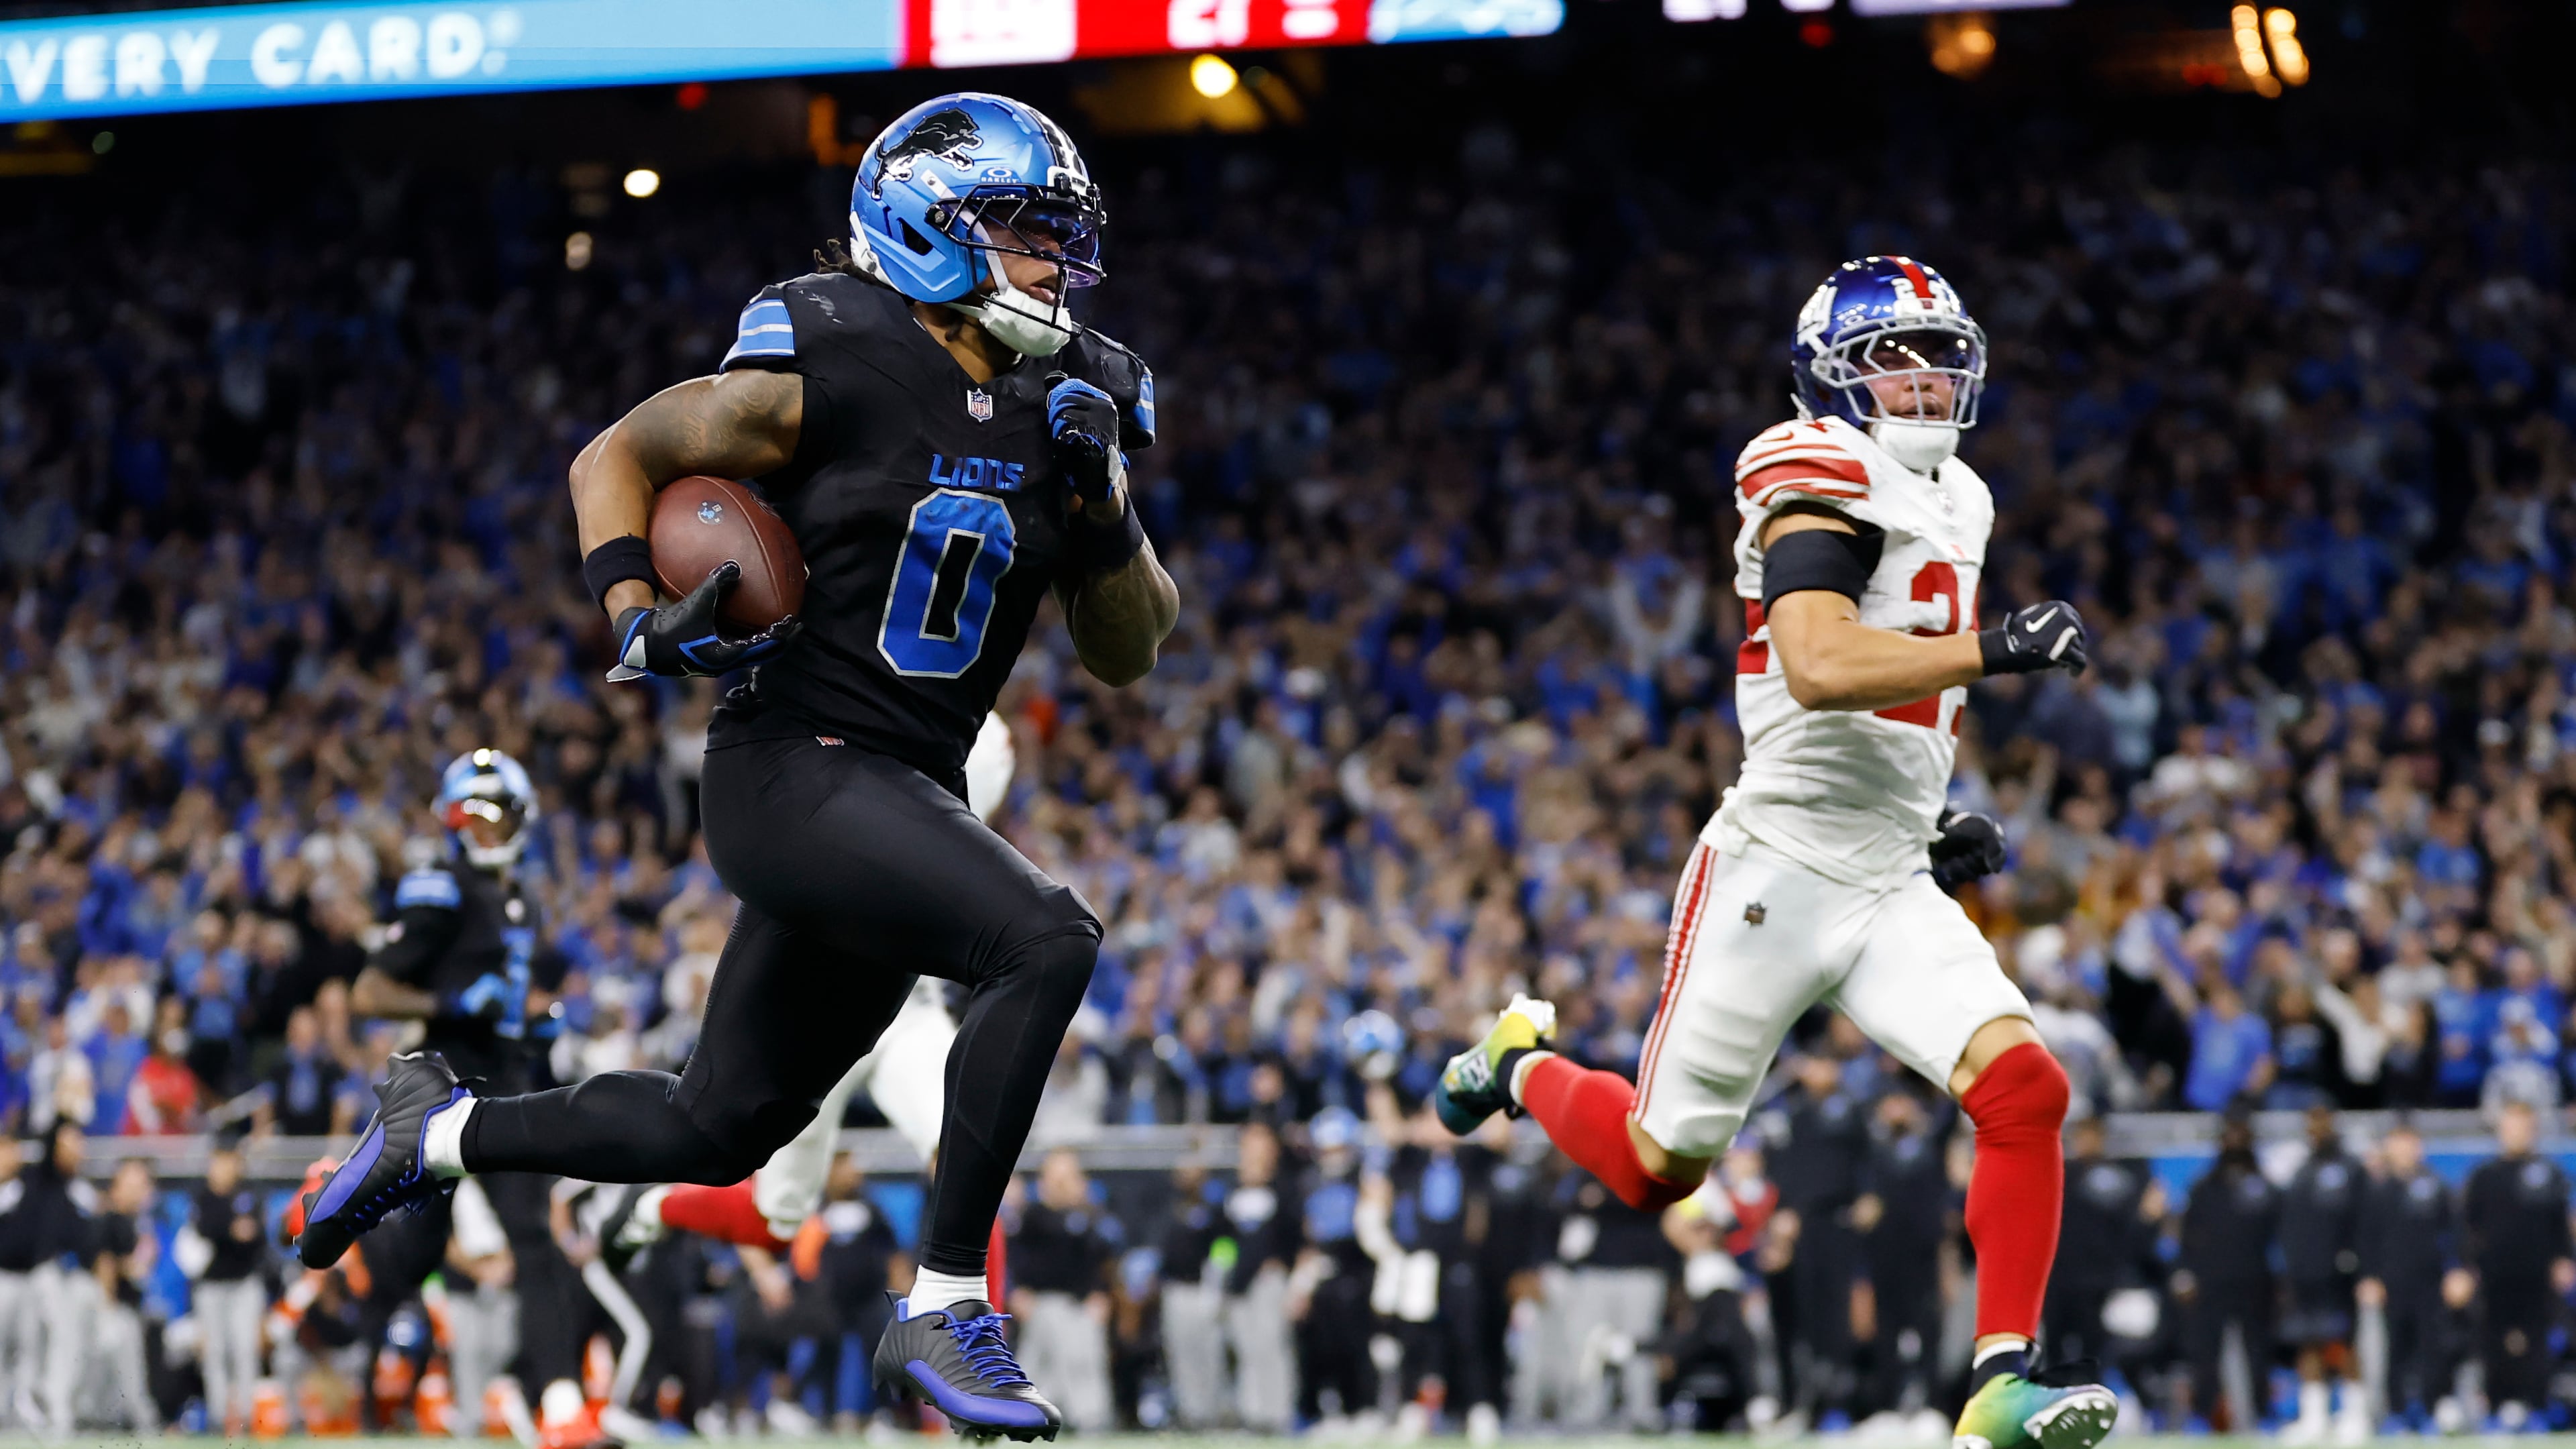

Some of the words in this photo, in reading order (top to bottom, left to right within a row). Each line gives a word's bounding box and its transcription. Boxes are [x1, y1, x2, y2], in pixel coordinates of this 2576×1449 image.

[0, 29, 220, 103] VERY
[876, 487, 1018, 679] 0
[1874, 560, 1981, 736] 2
